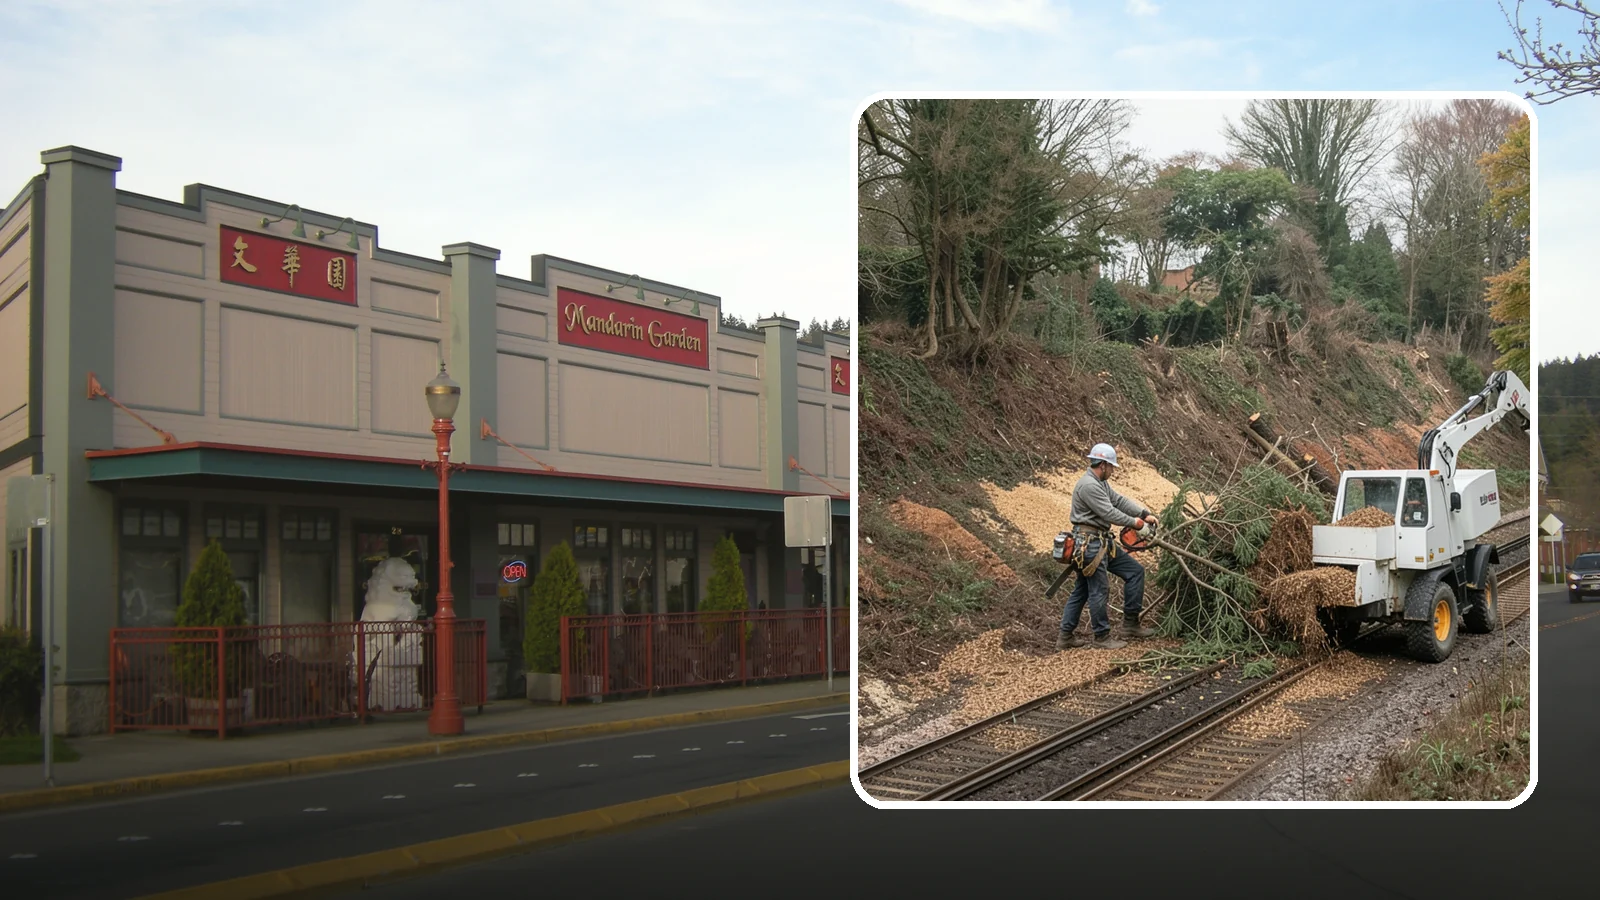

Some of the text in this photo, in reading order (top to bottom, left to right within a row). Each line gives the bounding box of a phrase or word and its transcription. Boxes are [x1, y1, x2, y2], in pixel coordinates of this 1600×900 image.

[230, 236, 346, 290] 文華園
[564, 302, 702, 352] Mandarin Garden
[834, 363, 846, 386] 文
[503, 565, 527, 578] OPEN
